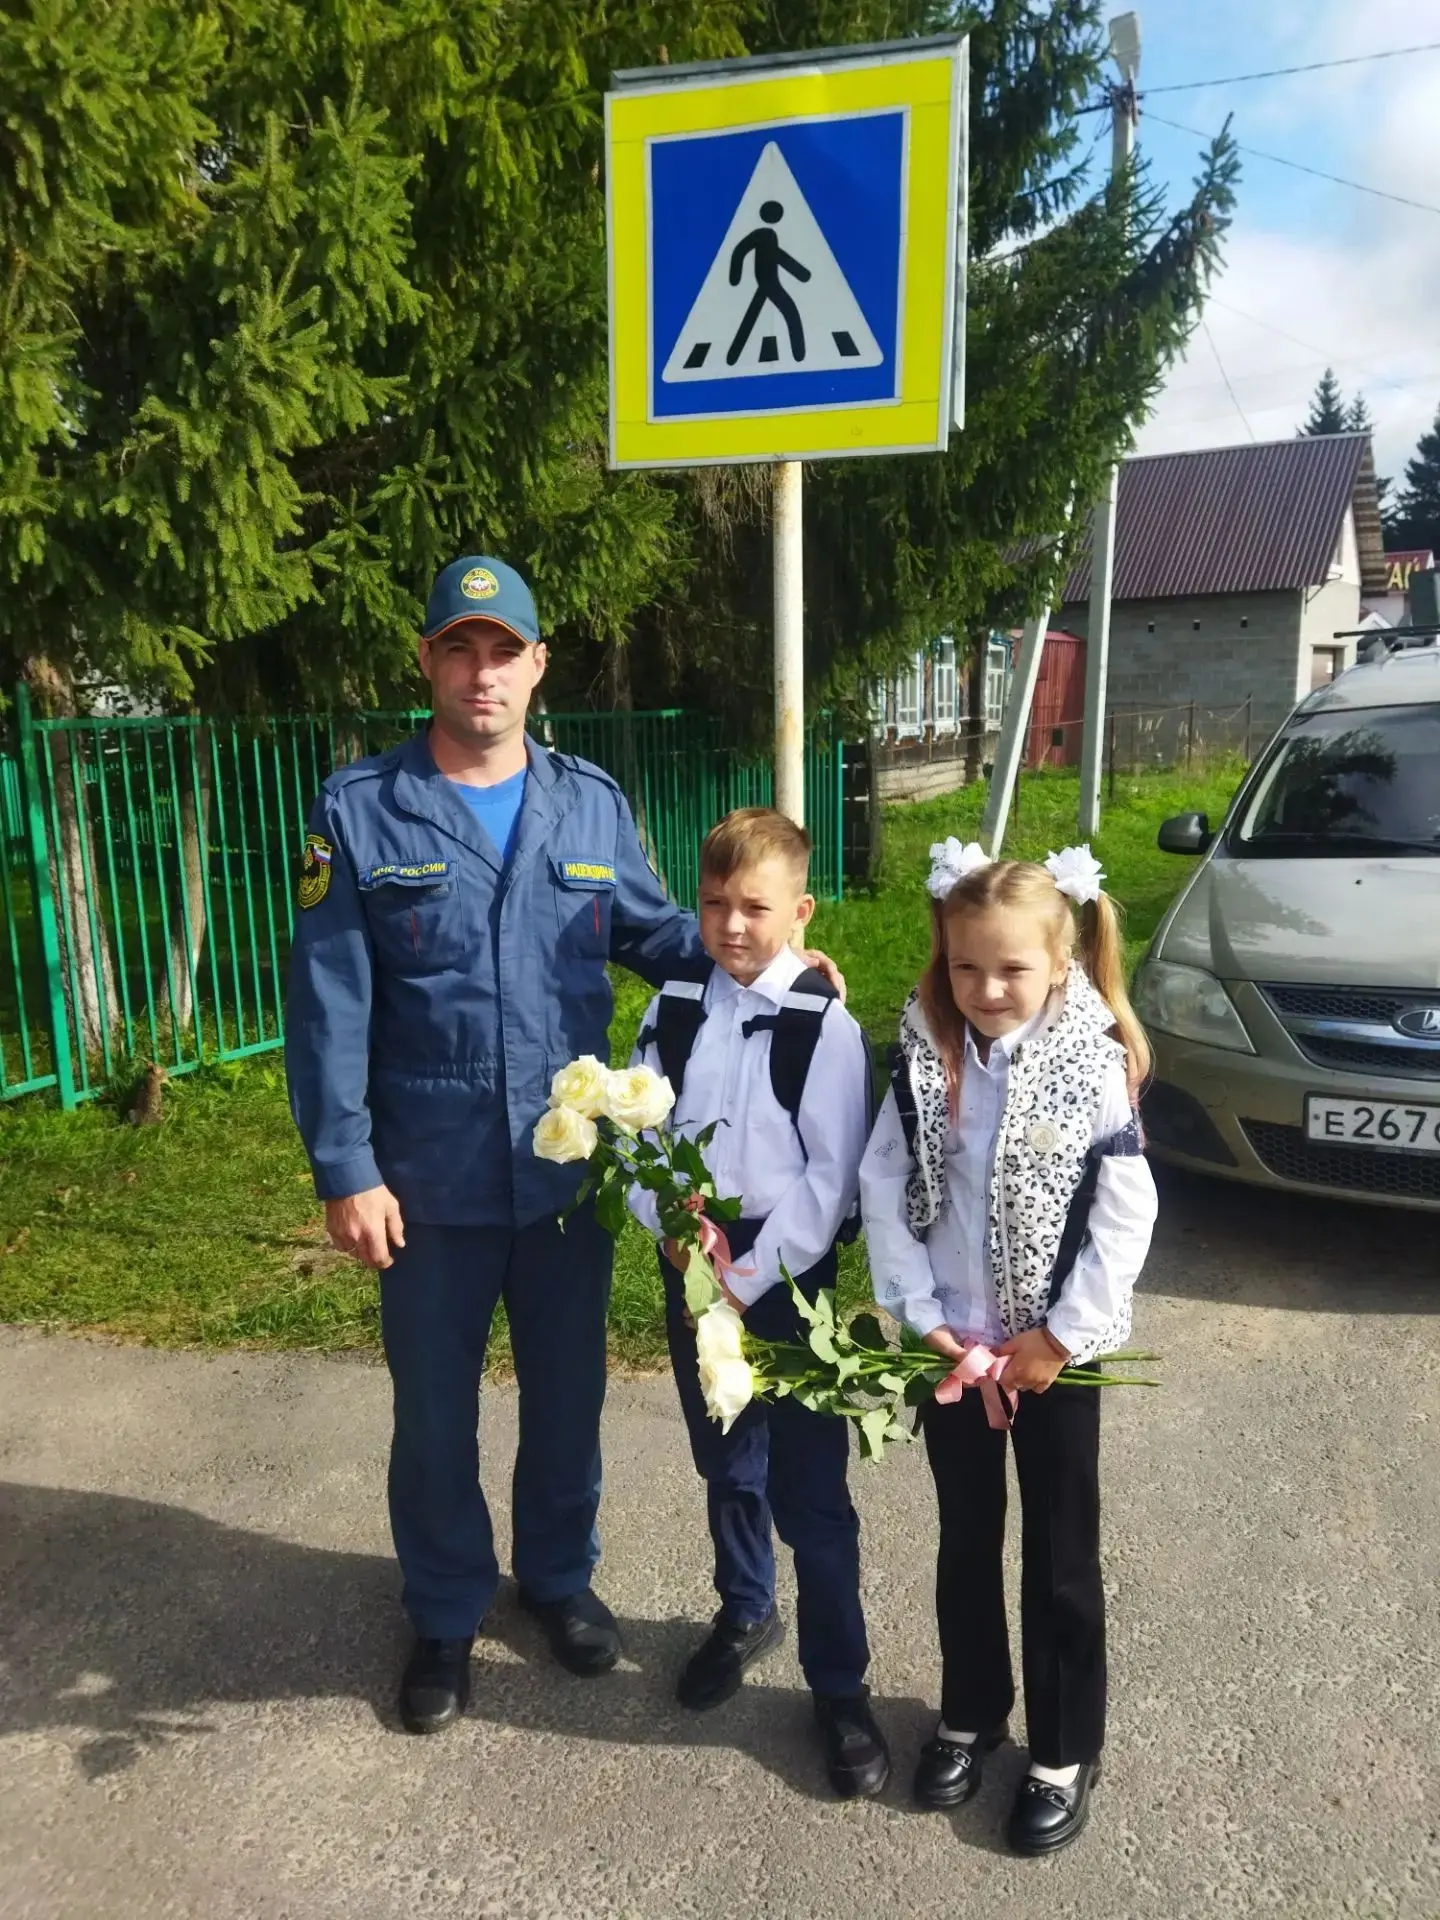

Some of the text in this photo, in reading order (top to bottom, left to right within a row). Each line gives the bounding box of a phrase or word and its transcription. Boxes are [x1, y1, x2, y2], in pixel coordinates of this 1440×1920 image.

[371, 862, 446, 878] МЧС РОССИИ
[1325, 1106, 1440, 1144] Е267
